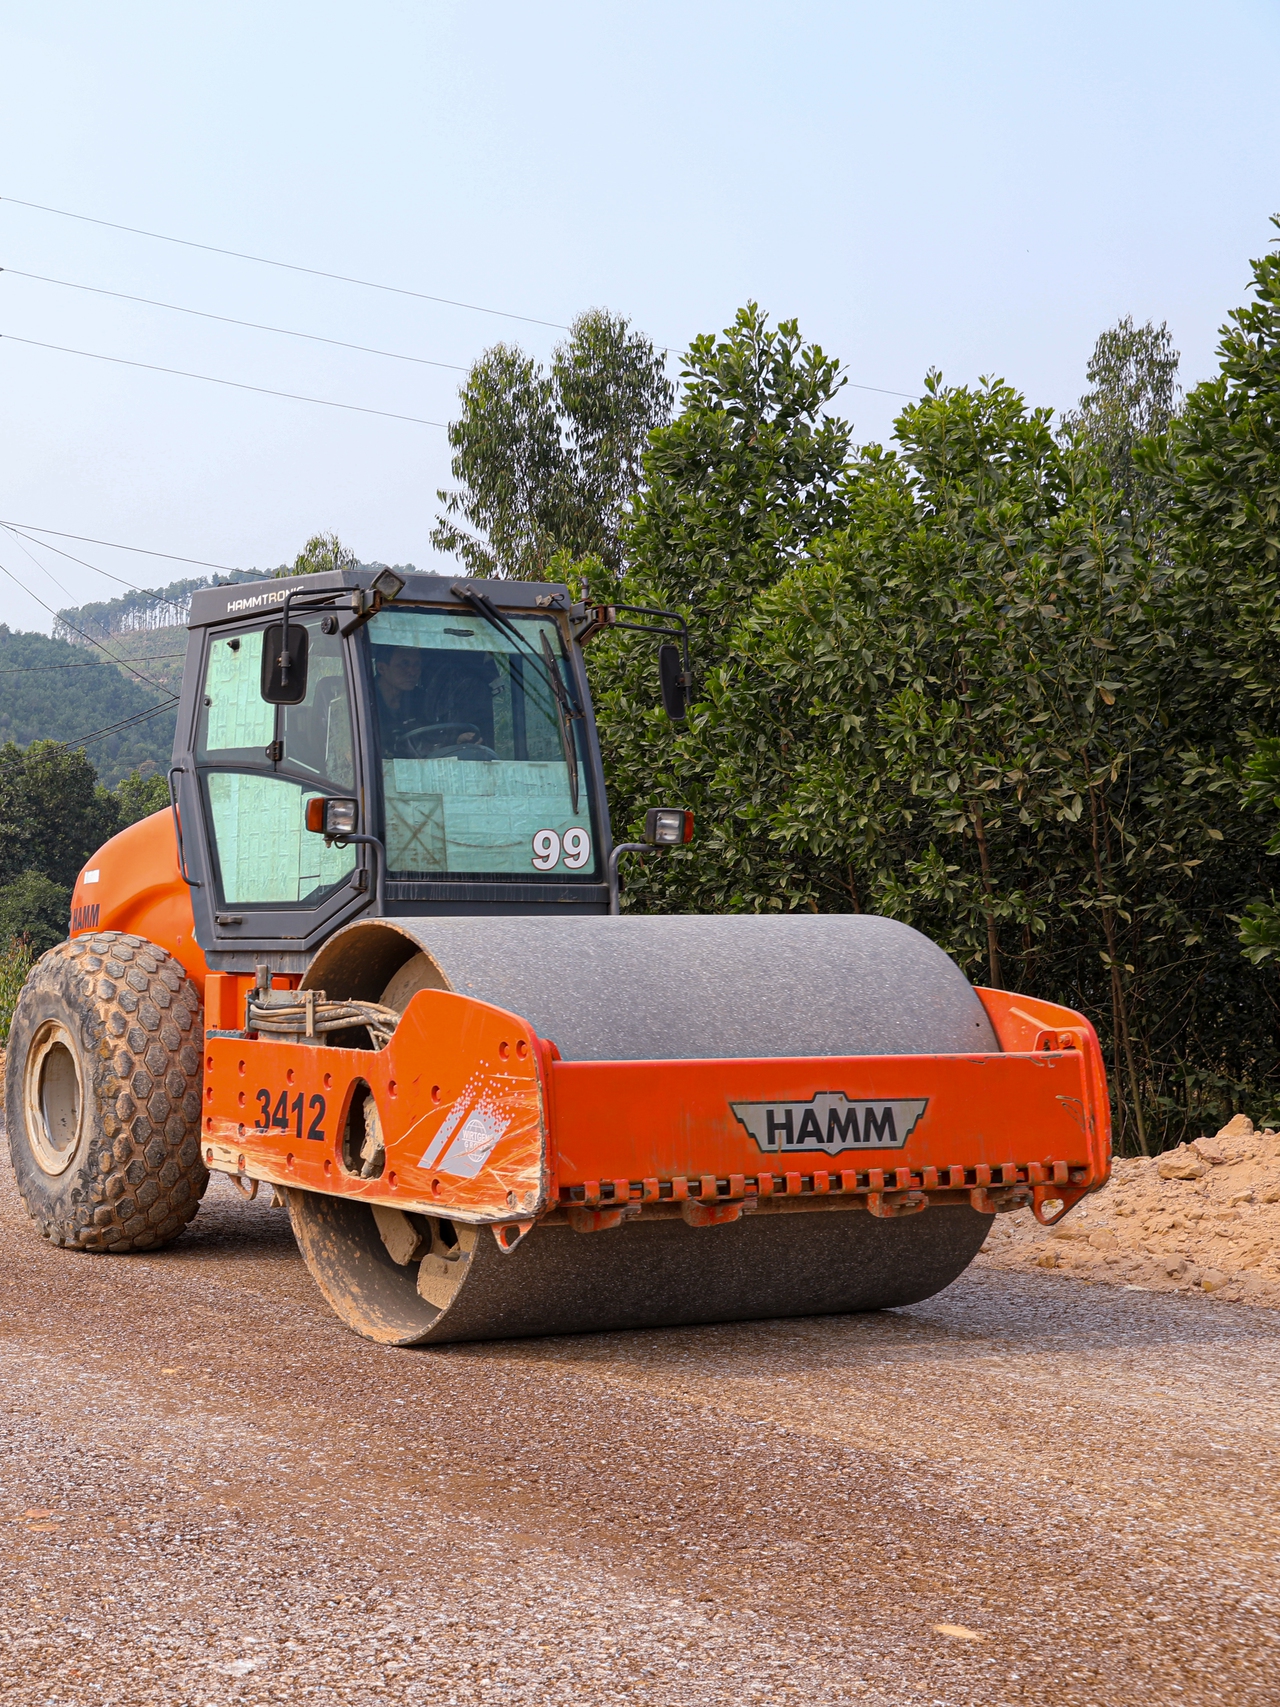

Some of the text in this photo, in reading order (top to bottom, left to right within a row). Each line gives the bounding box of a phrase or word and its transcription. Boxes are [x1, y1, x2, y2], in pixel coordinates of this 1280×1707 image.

[531, 826, 591, 871] 99
[73, 903, 100, 931] HAMM
[254, 1088, 326, 1142] 3412
[766, 1107, 898, 1145] HAMM
